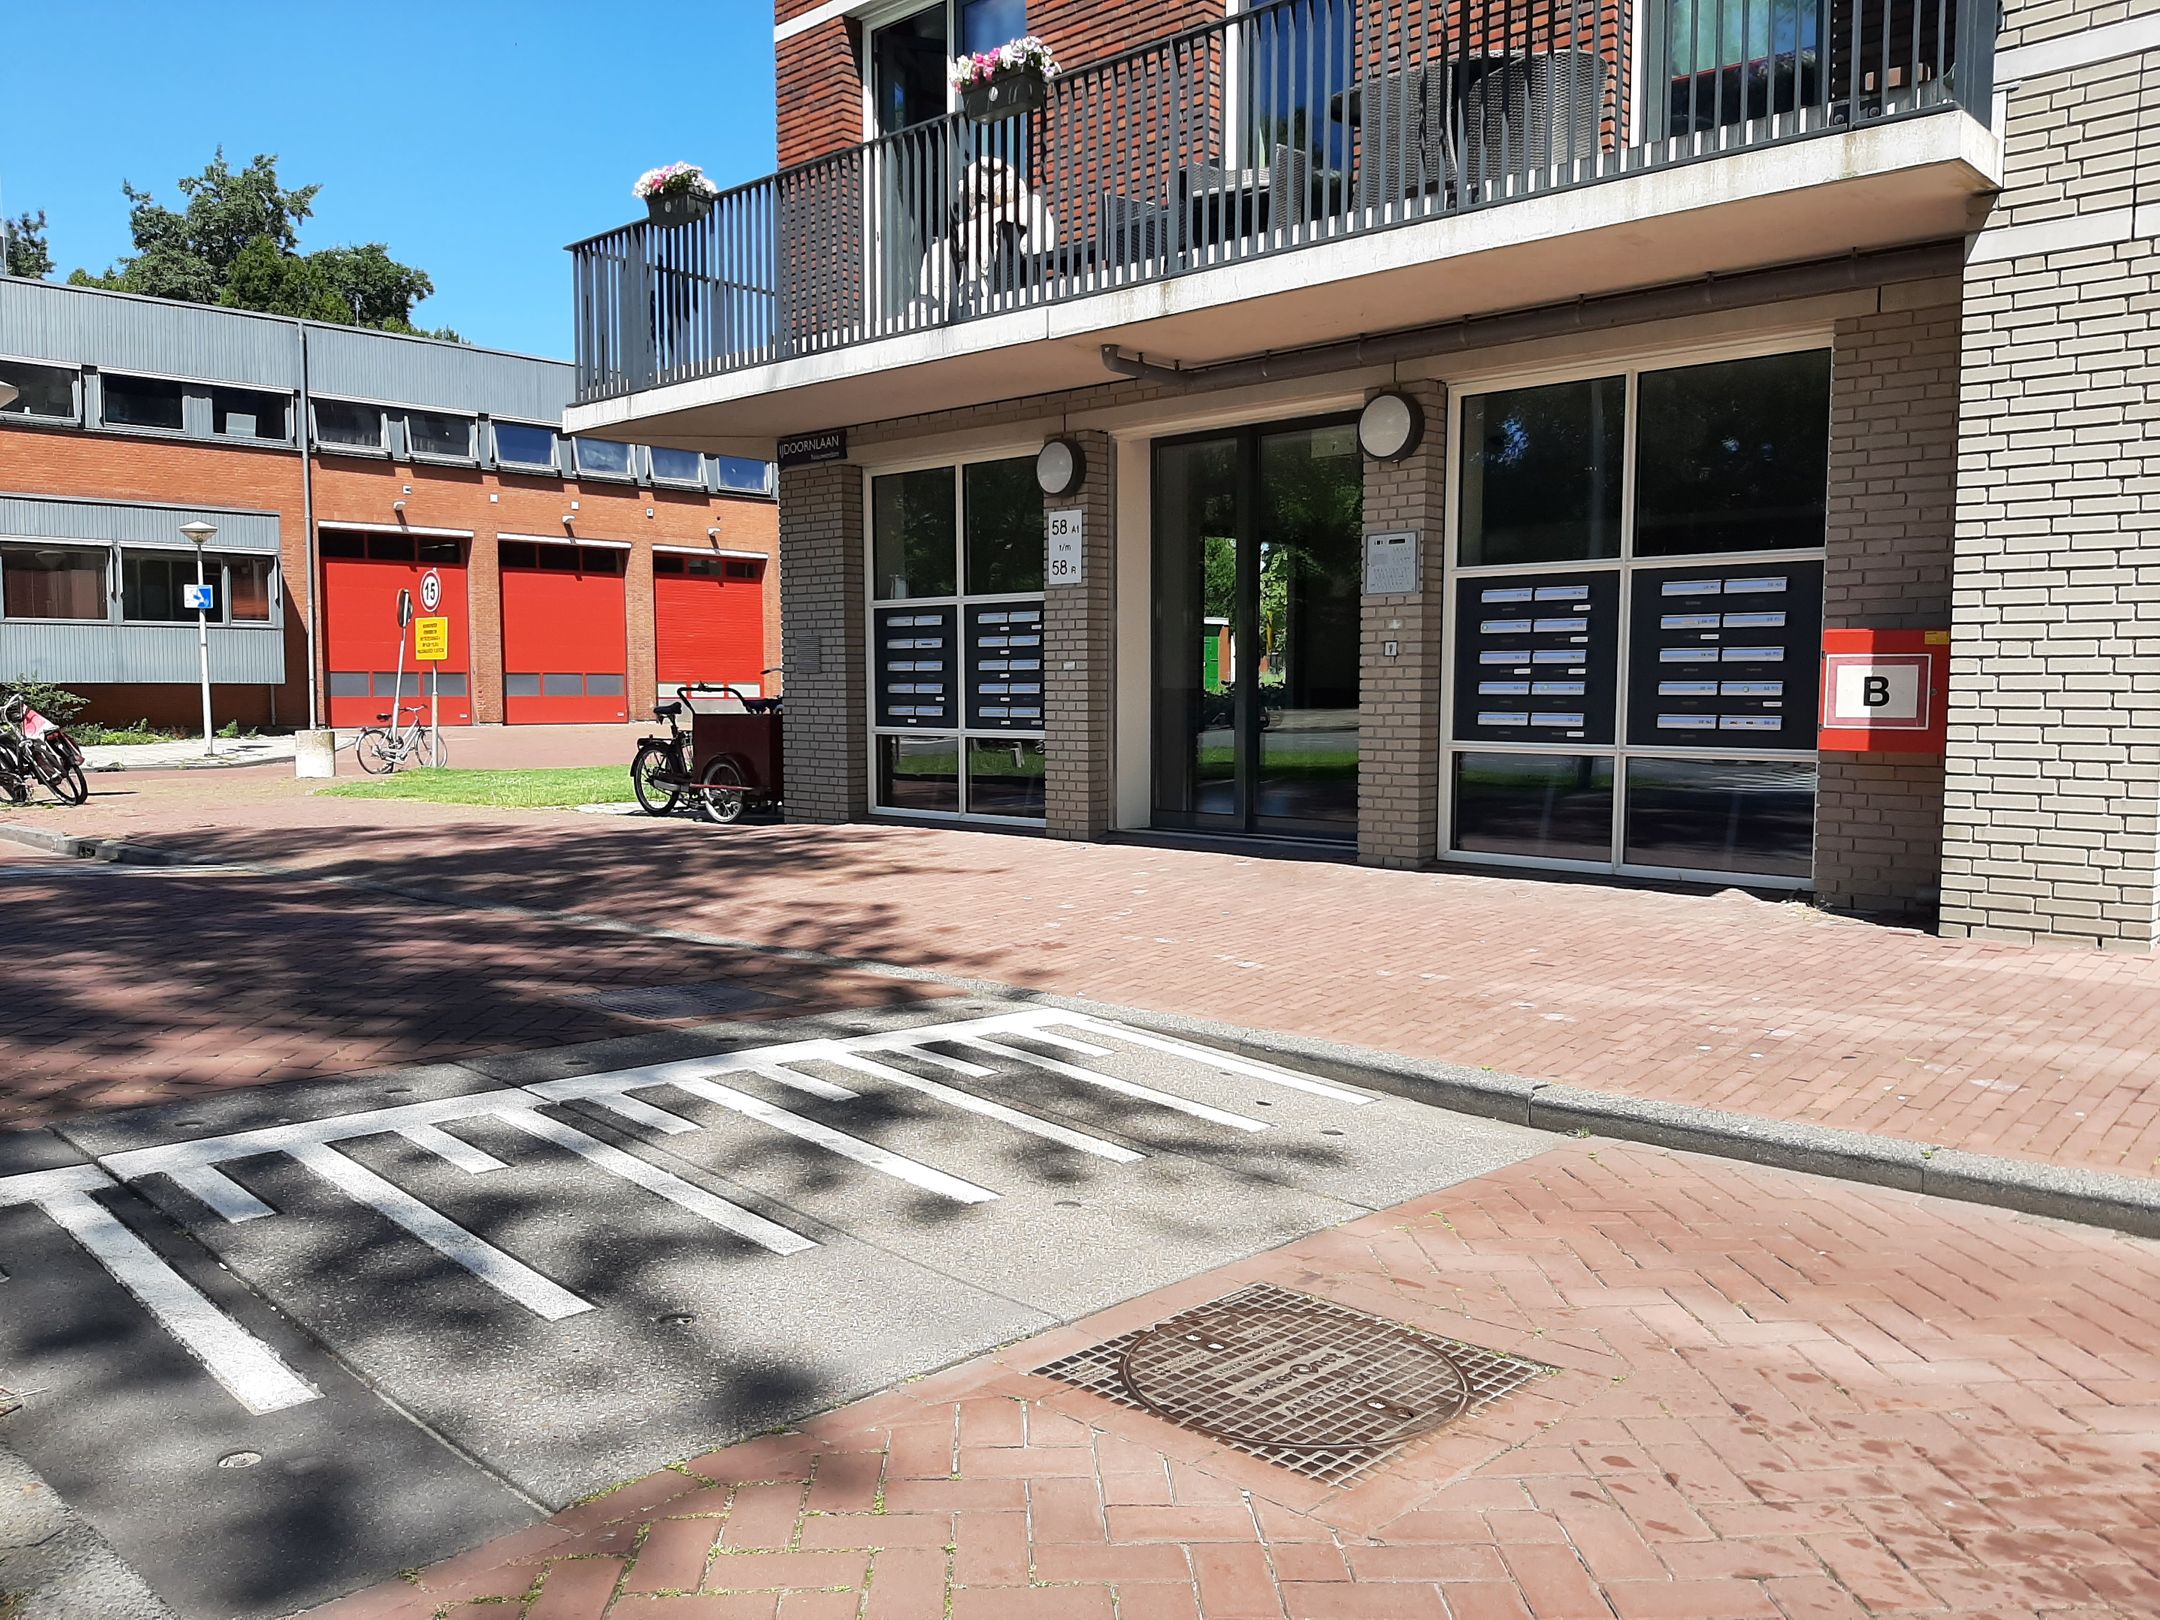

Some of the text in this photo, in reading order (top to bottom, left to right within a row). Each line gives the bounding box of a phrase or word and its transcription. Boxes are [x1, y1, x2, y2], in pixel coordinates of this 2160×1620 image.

[779, 435, 839, 459] IJDOORNLAAN
[1052, 519, 1068, 536] 58
[1059, 544, 1072, 552] t/m
[1052, 560, 1068, 576] 58
[425, 583, 436, 600] 15
[1863, 676, 1890, 707] B
[1285, 1366, 1388, 1416] AMSTERDAM
